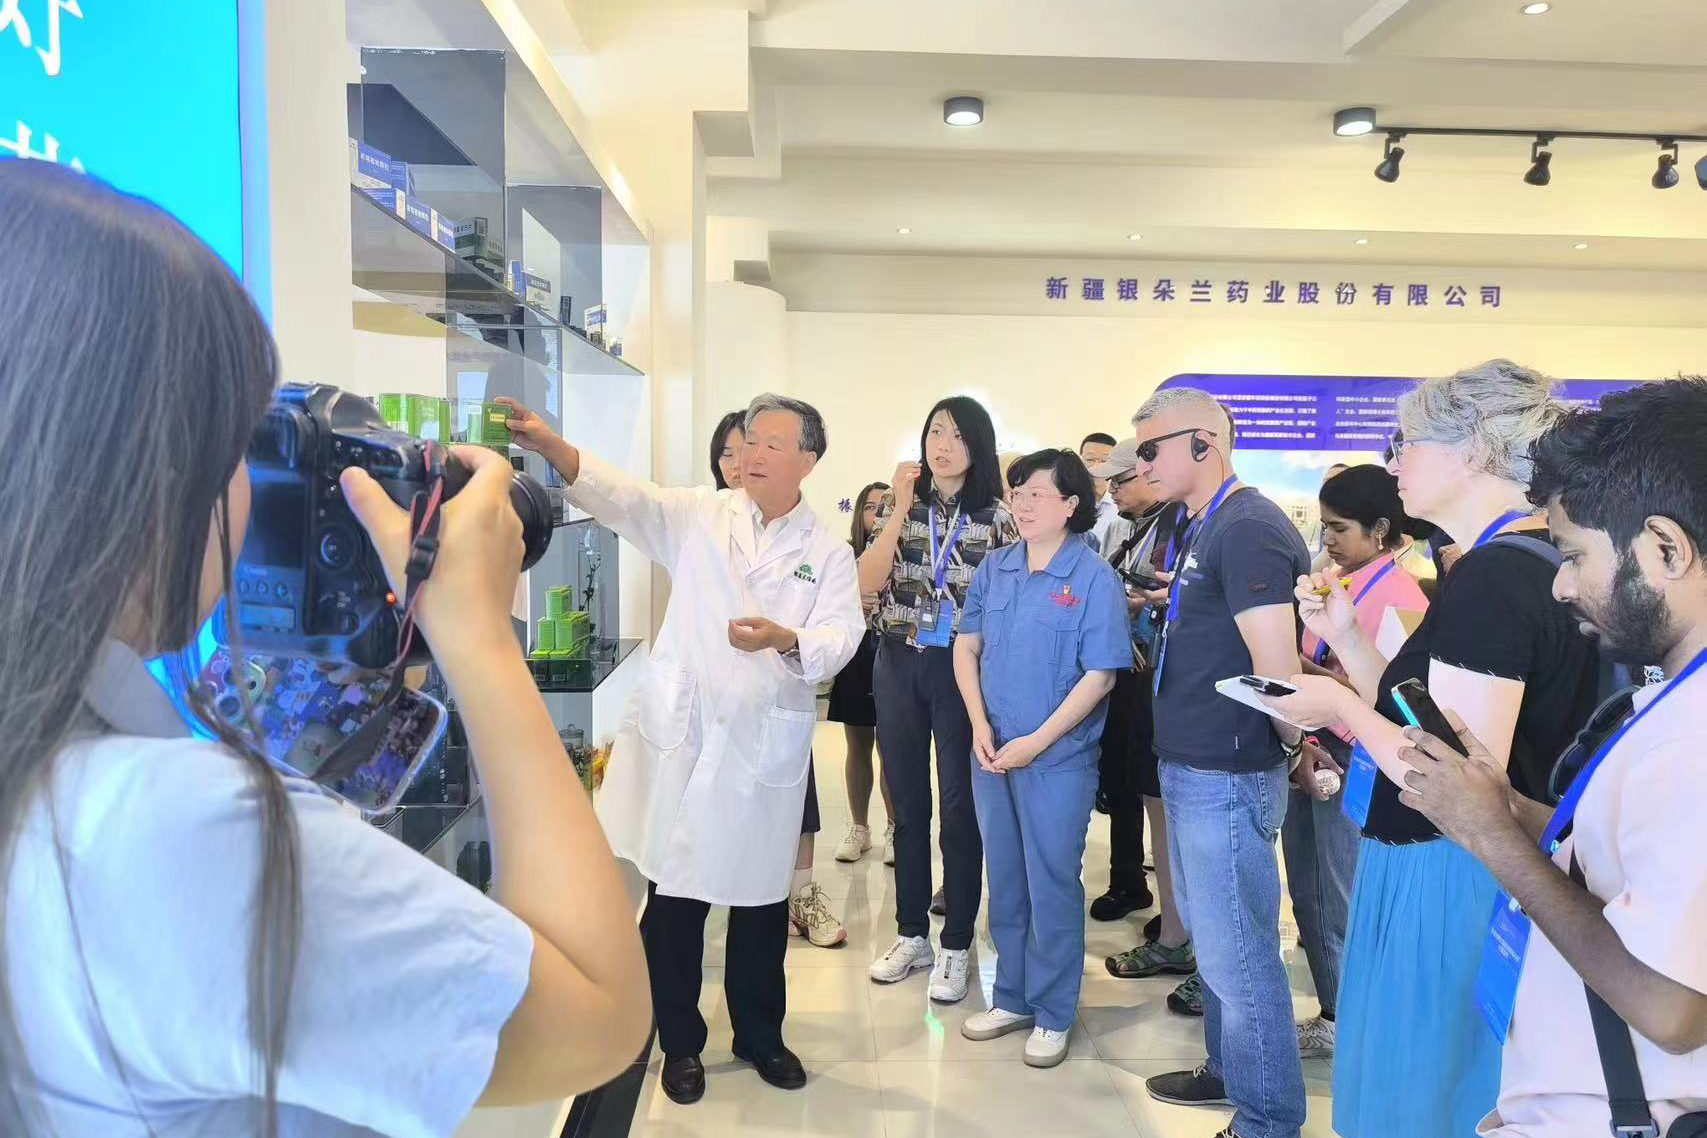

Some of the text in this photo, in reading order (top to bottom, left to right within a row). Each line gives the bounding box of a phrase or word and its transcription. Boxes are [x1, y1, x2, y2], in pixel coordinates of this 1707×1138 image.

[1046, 277, 1501, 307] 新疆银朵兰药业股份有限公司
